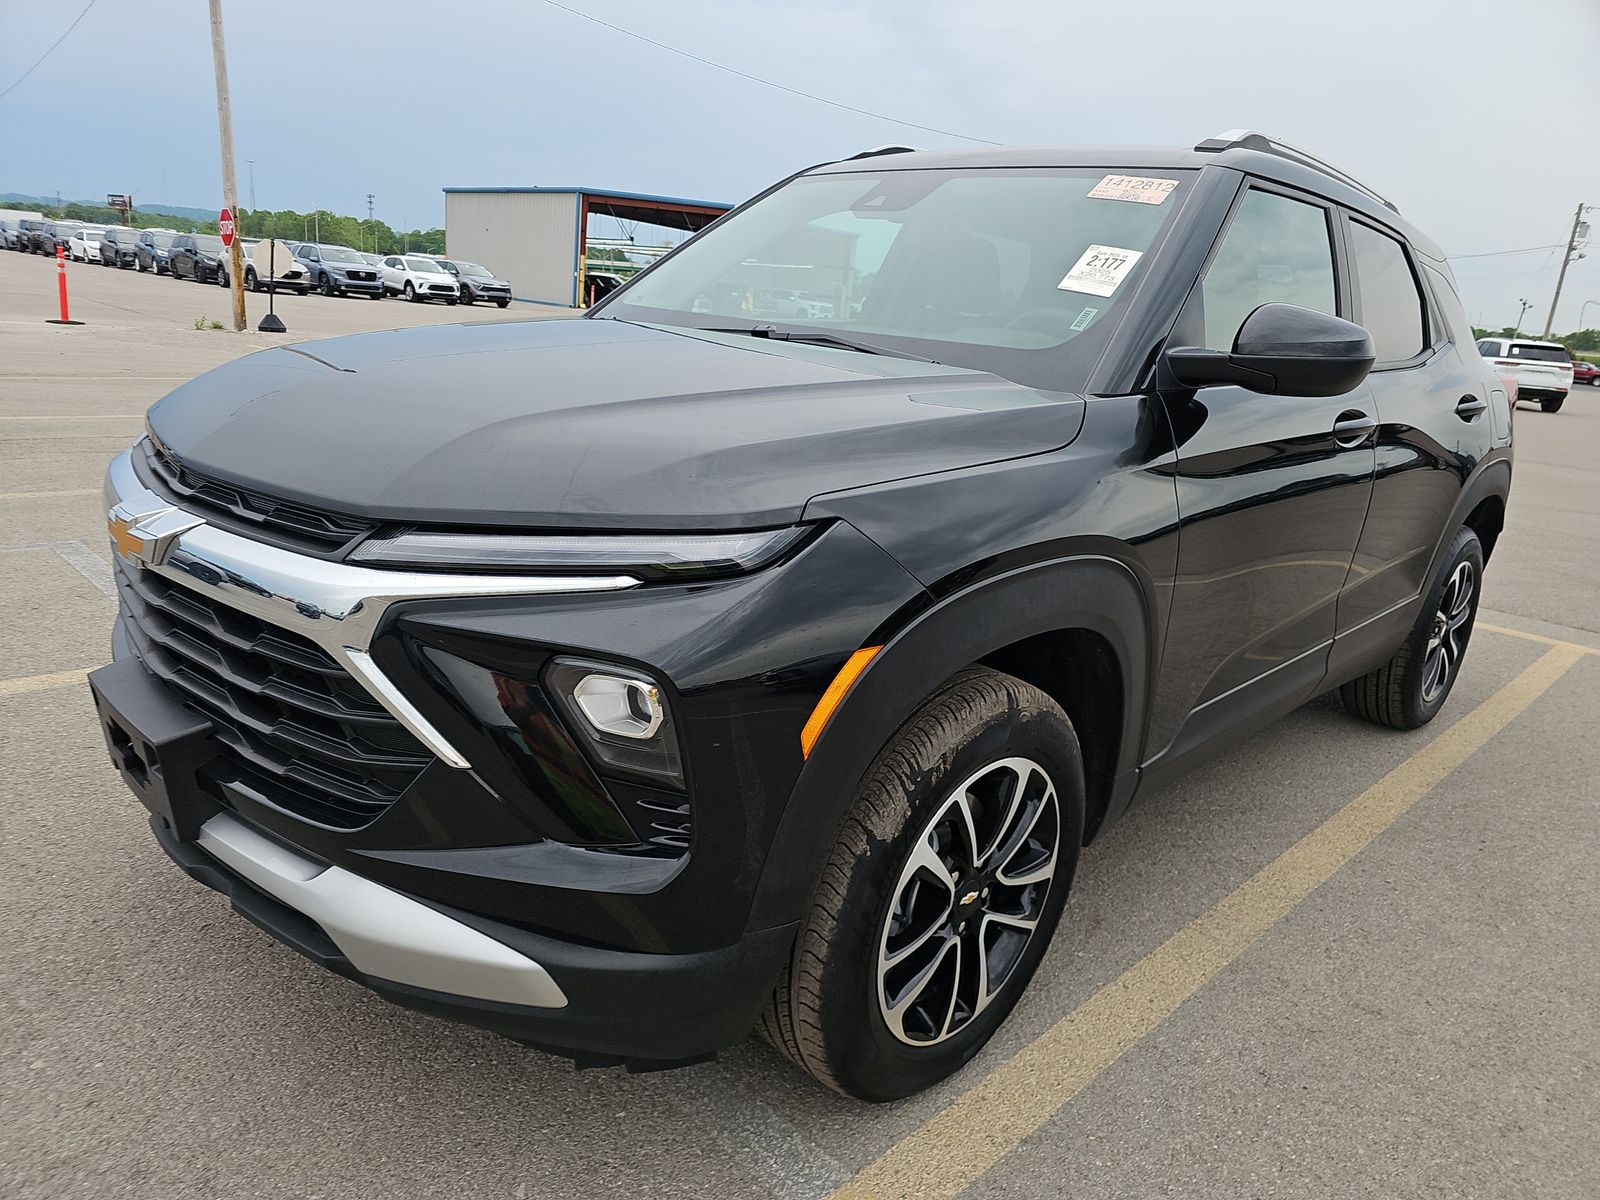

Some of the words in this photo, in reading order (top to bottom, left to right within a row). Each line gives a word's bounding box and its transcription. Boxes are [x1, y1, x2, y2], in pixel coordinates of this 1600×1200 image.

[1104, 178, 1175, 193] 1412812
[220, 220, 233, 235] STOP
[1086, 255, 1126, 270] 2:177
